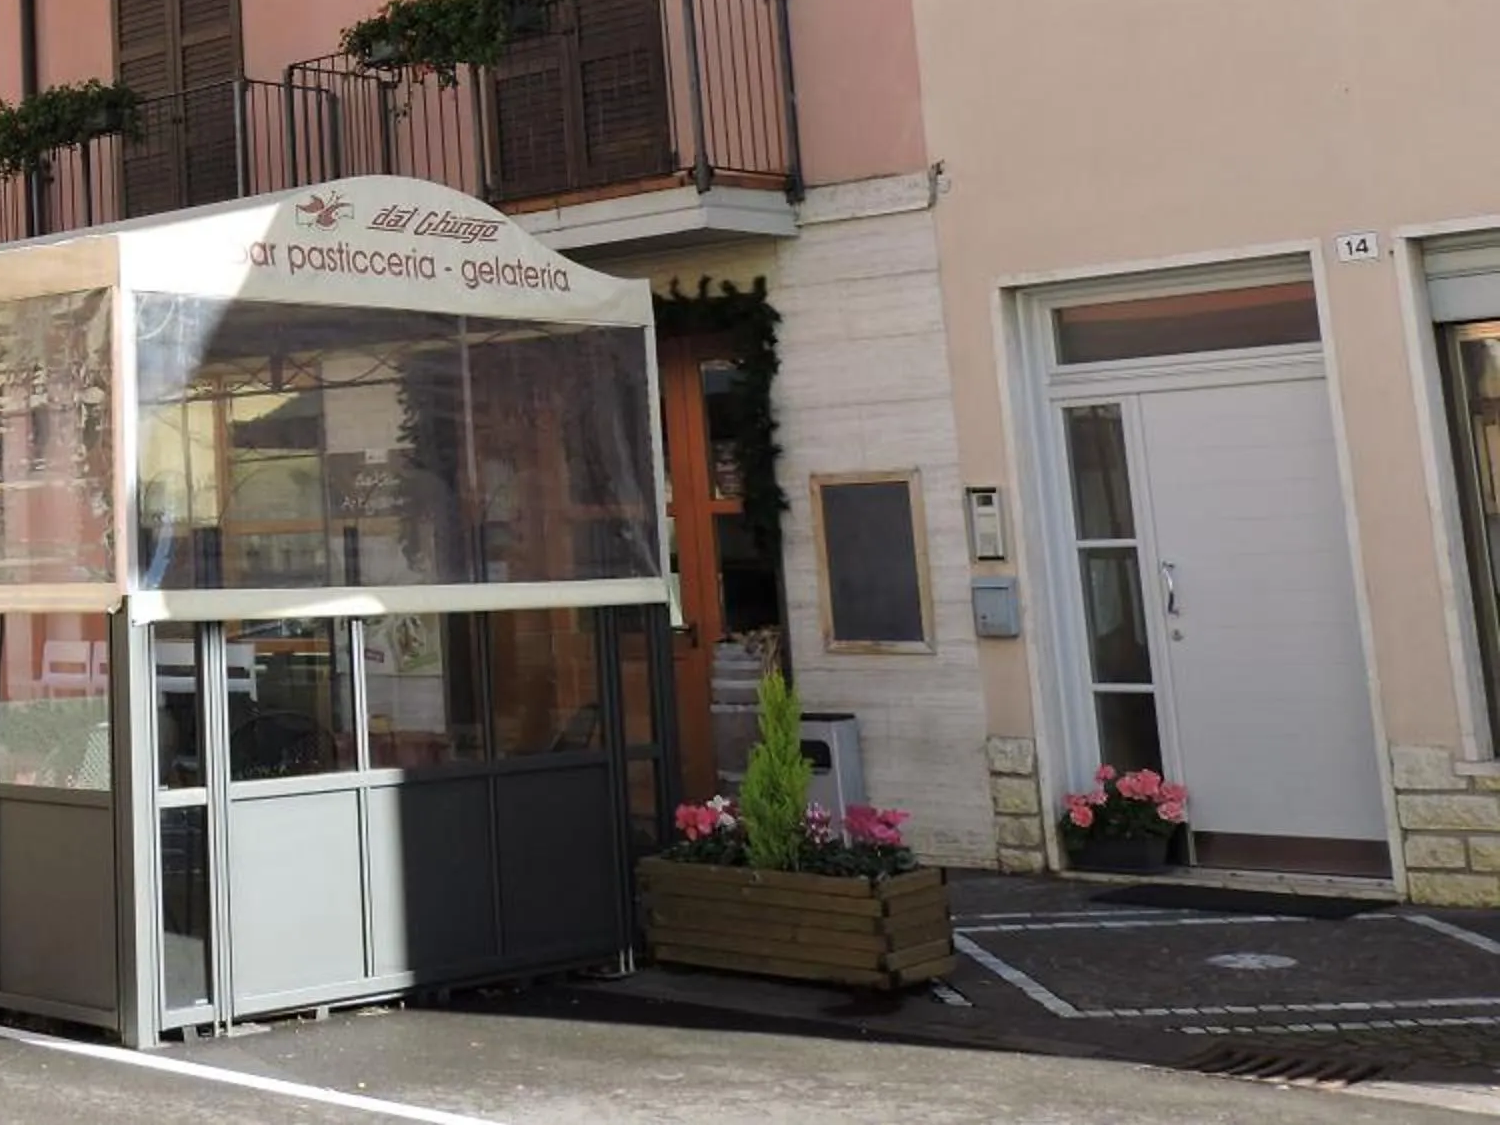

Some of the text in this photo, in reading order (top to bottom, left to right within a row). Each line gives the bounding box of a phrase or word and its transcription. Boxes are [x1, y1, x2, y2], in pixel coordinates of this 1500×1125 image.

[1345, 238, 1369, 256] 14
[287, 242, 436, 278] pasticceria
[461, 257, 571, 292] gelateria
